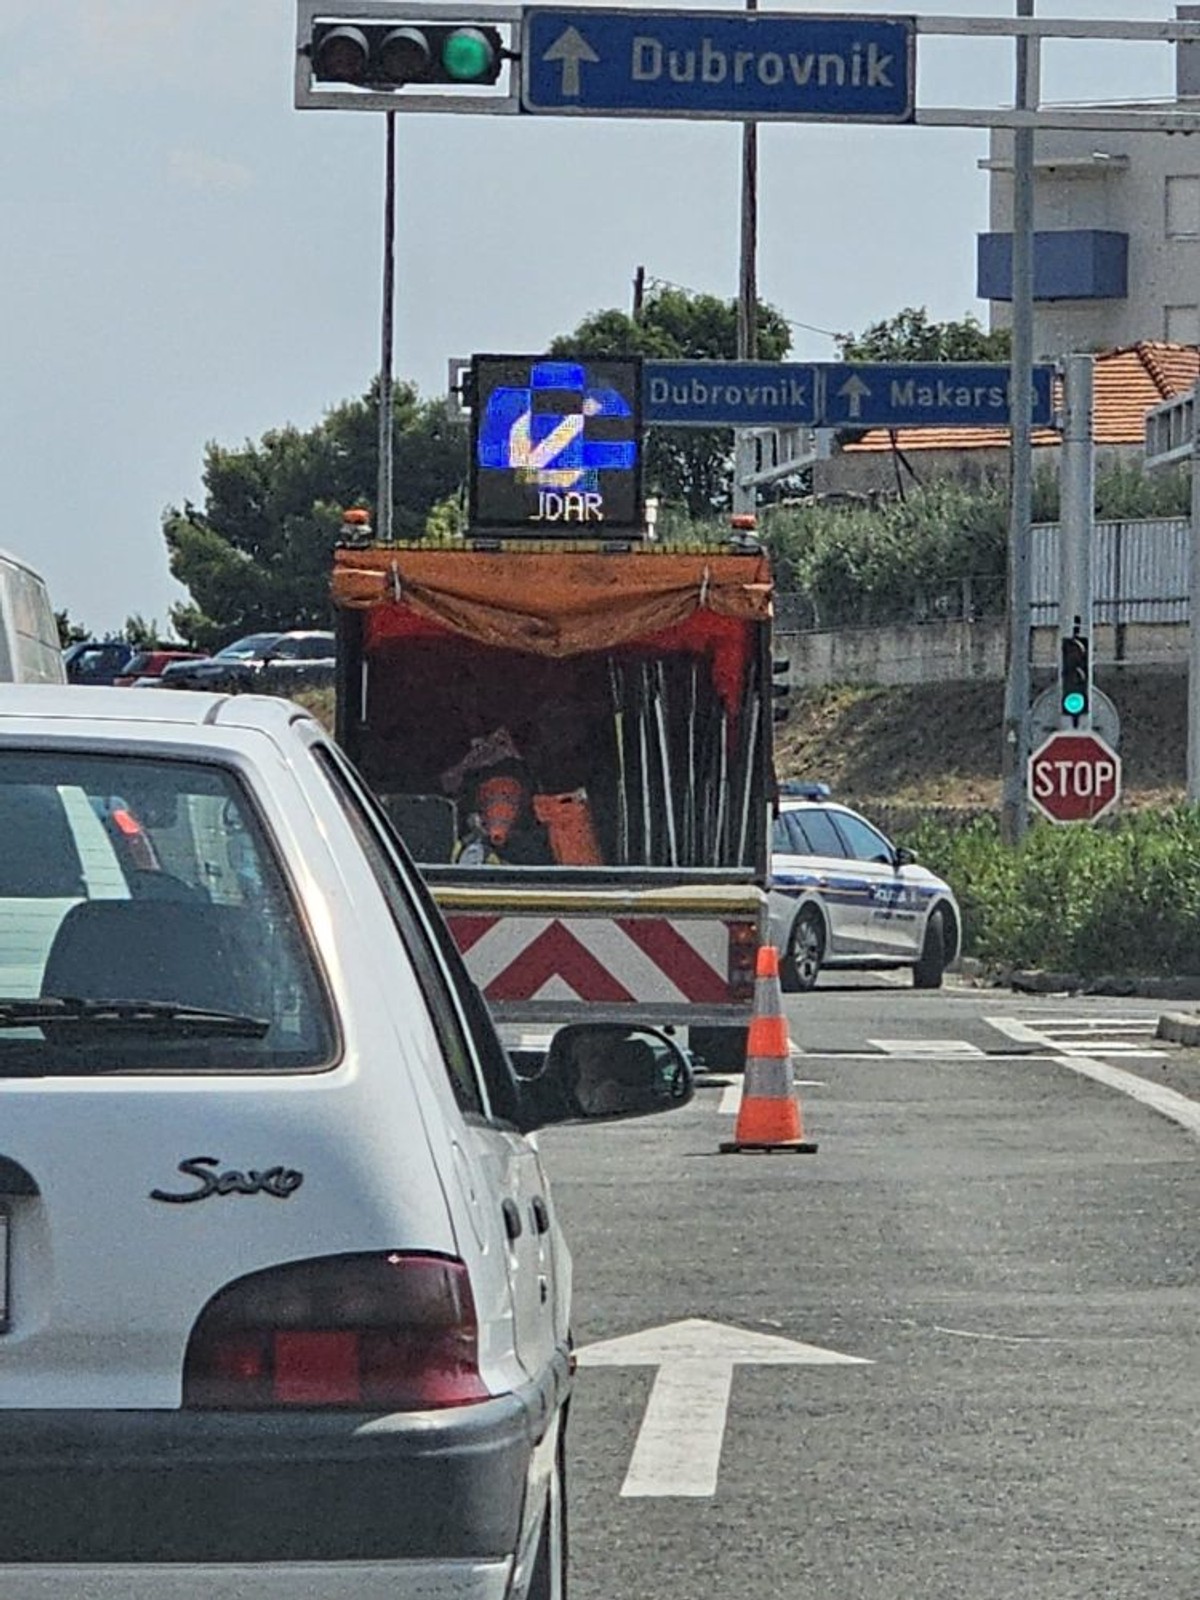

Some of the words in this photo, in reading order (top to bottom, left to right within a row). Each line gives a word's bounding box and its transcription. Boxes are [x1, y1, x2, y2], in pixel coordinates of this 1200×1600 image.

[631, 36, 895, 87] Dubrovnik
[650, 378, 806, 406] Dubrovnik
[890, 379, 1039, 408] Makars
[1034, 761, 1114, 798] STOP
[150, 1156, 304, 1203] Saxo
